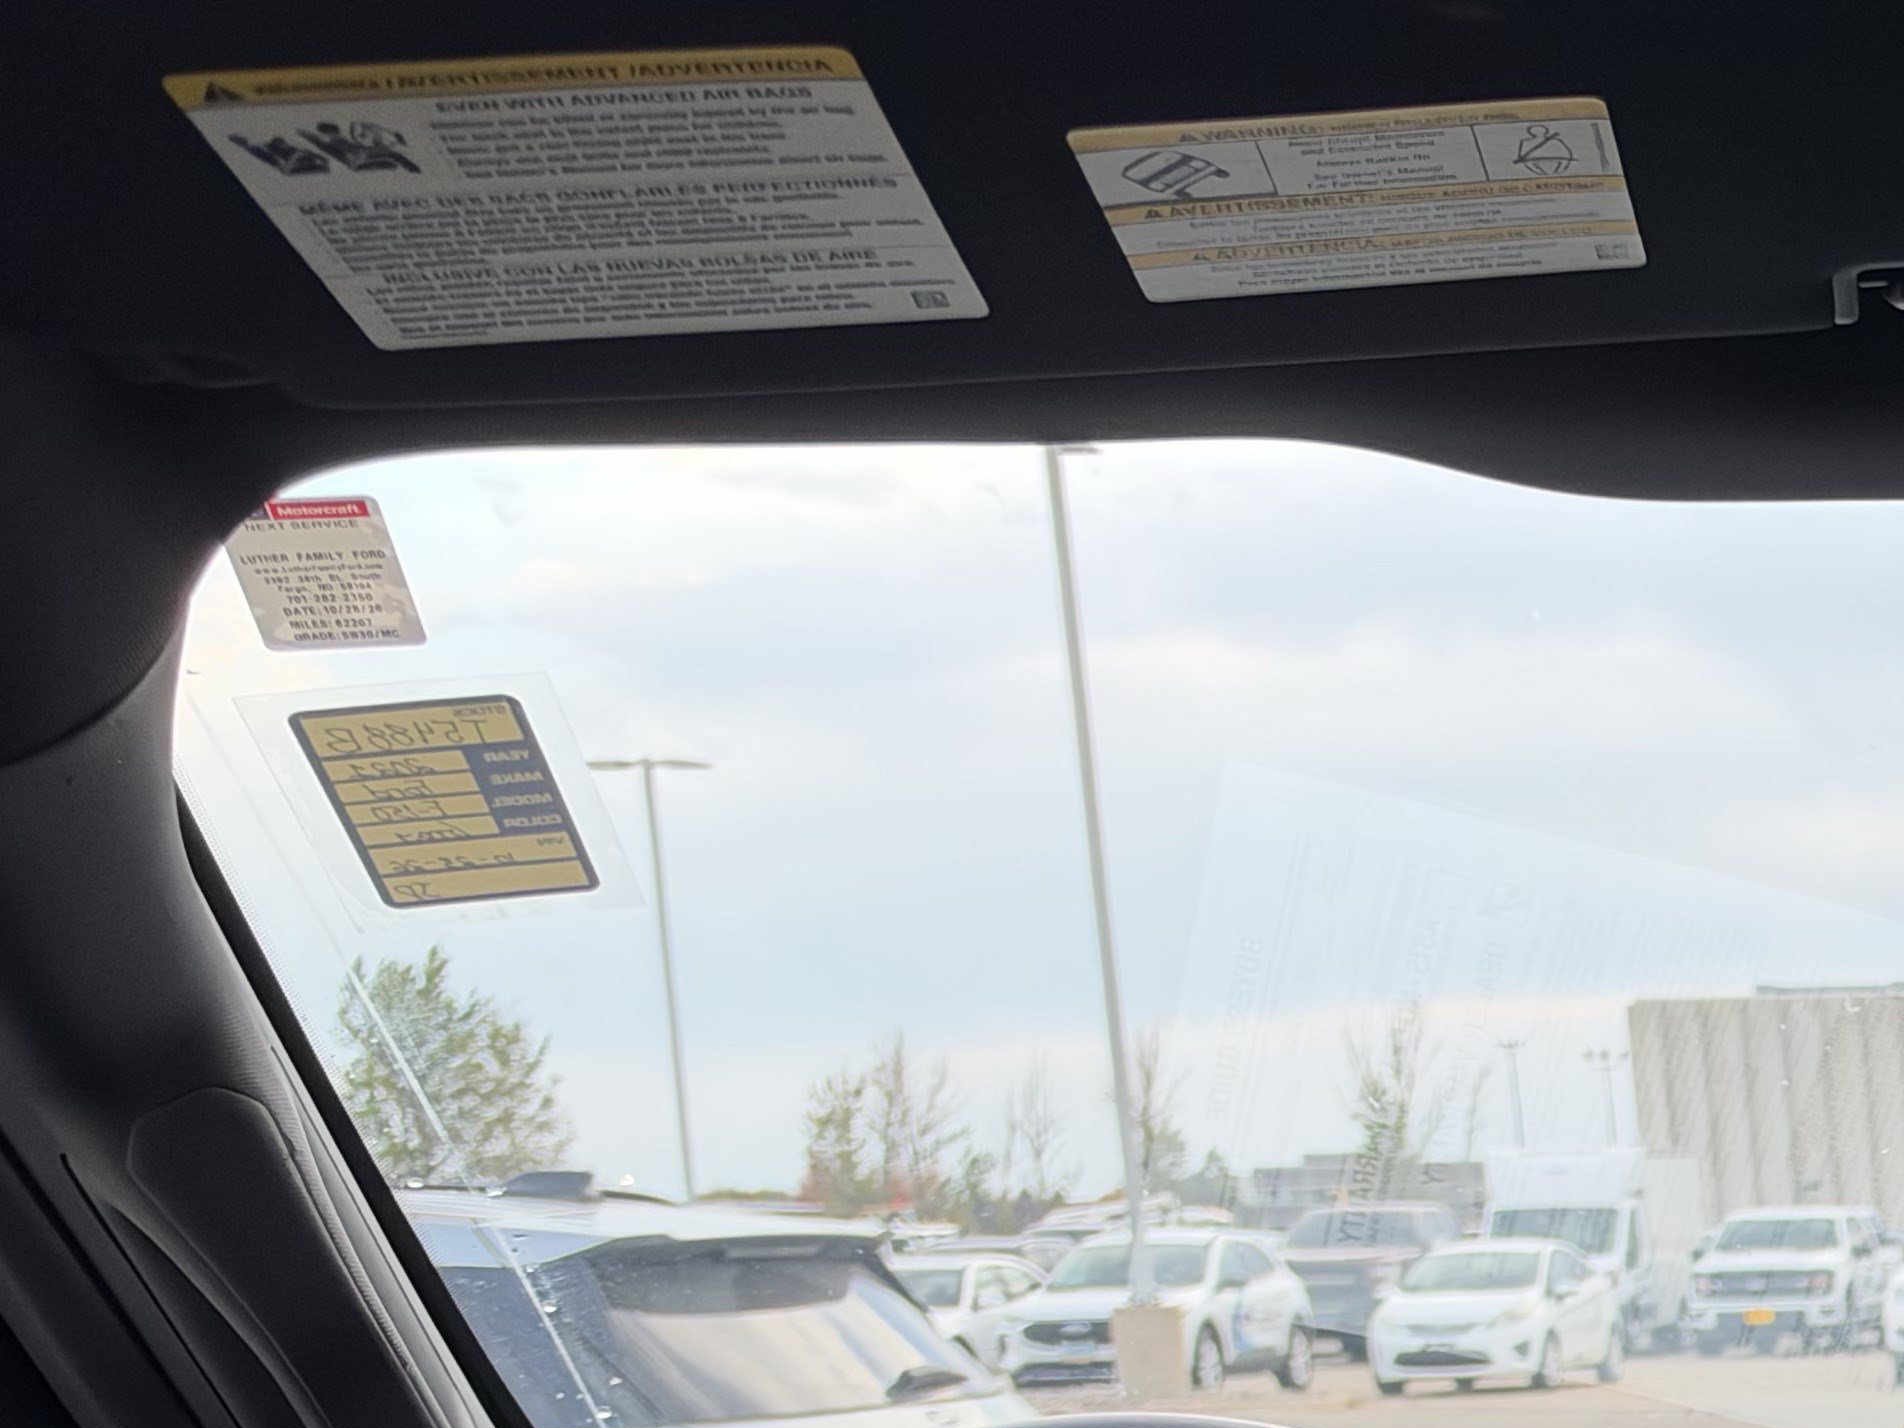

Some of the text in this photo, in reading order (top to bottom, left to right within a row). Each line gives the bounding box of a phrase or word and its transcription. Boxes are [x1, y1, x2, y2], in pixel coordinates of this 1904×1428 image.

[277, 504, 361, 517] Motorcraft
[245, 520, 359, 532] NEXT SERVICE
[239, 550, 386, 565] LUTHER FAMILY FORD
